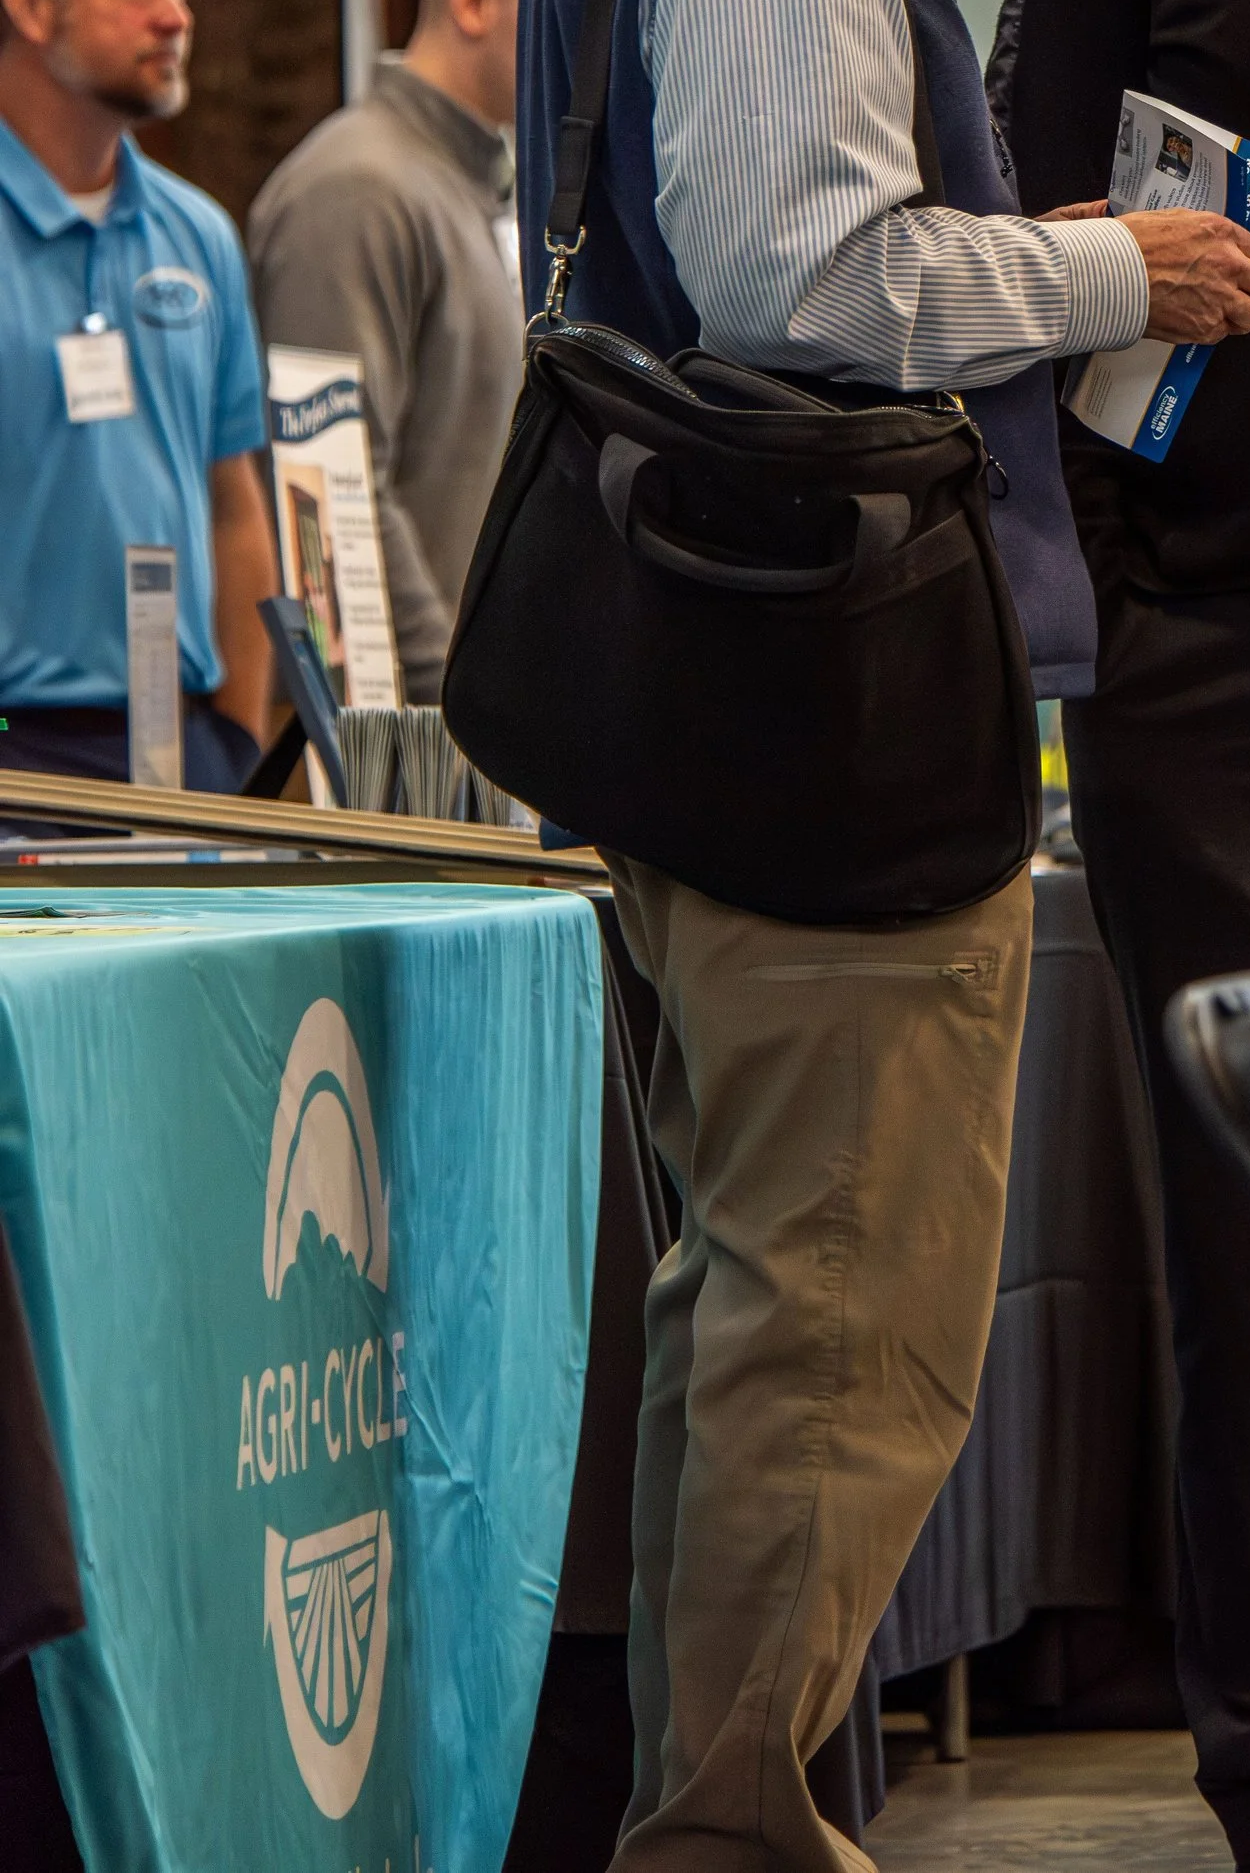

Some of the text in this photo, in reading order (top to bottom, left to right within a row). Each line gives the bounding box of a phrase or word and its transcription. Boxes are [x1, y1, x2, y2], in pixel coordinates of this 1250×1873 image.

[1150, 393, 1170, 429] efficiency
[1155, 395, 1177, 433] MAINE
[236, 1331, 408, 1491] AGRI-CYCLE
